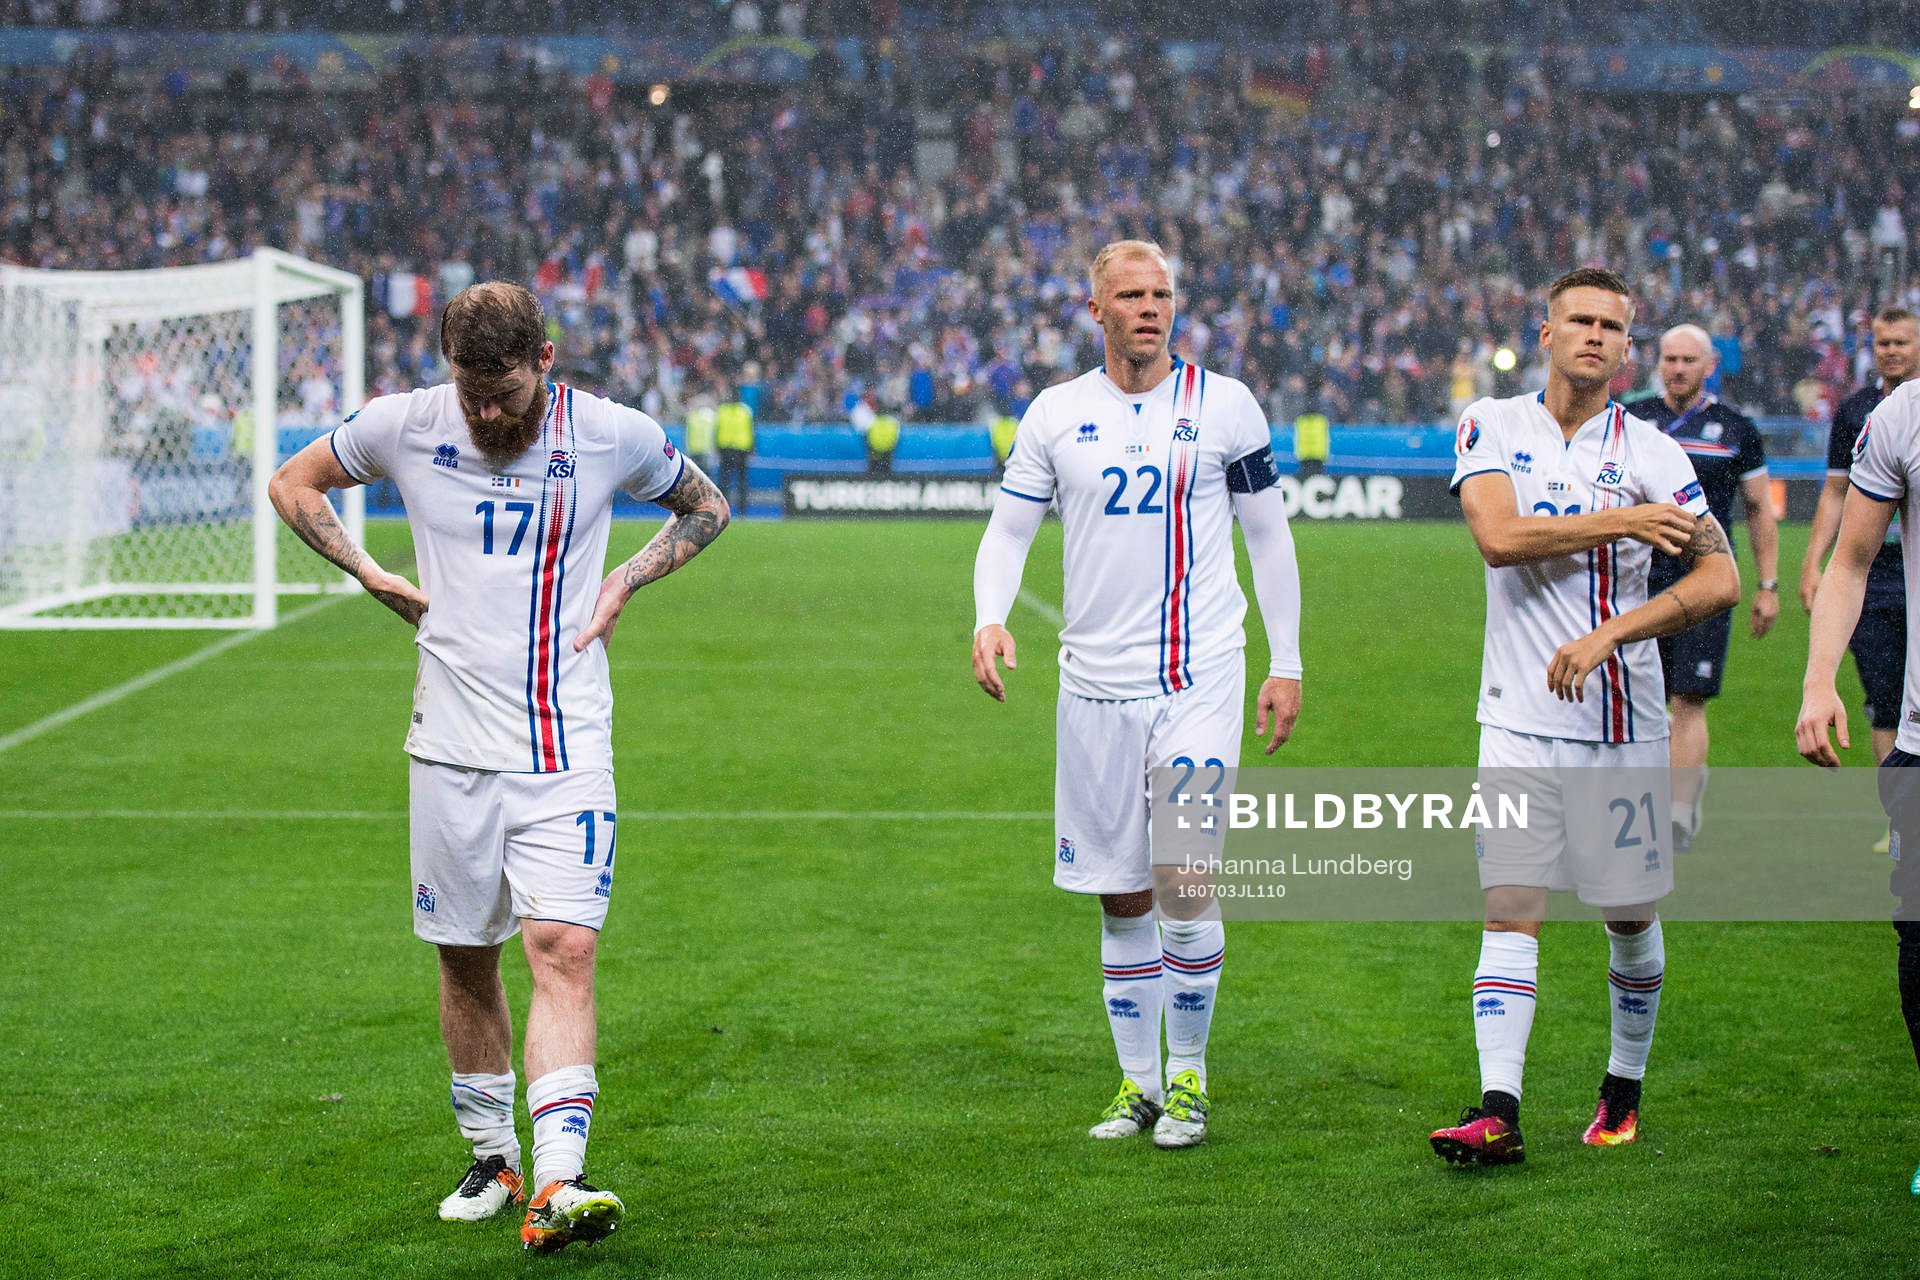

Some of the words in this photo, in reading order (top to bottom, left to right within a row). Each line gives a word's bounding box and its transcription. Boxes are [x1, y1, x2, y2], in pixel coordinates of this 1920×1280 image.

[1101, 465, 1163, 515] 22
[475, 500, 534, 555] 17
[1168, 756, 1225, 808] 22
[576, 810, 616, 867] 17
[1608, 791, 1657, 849] 21
